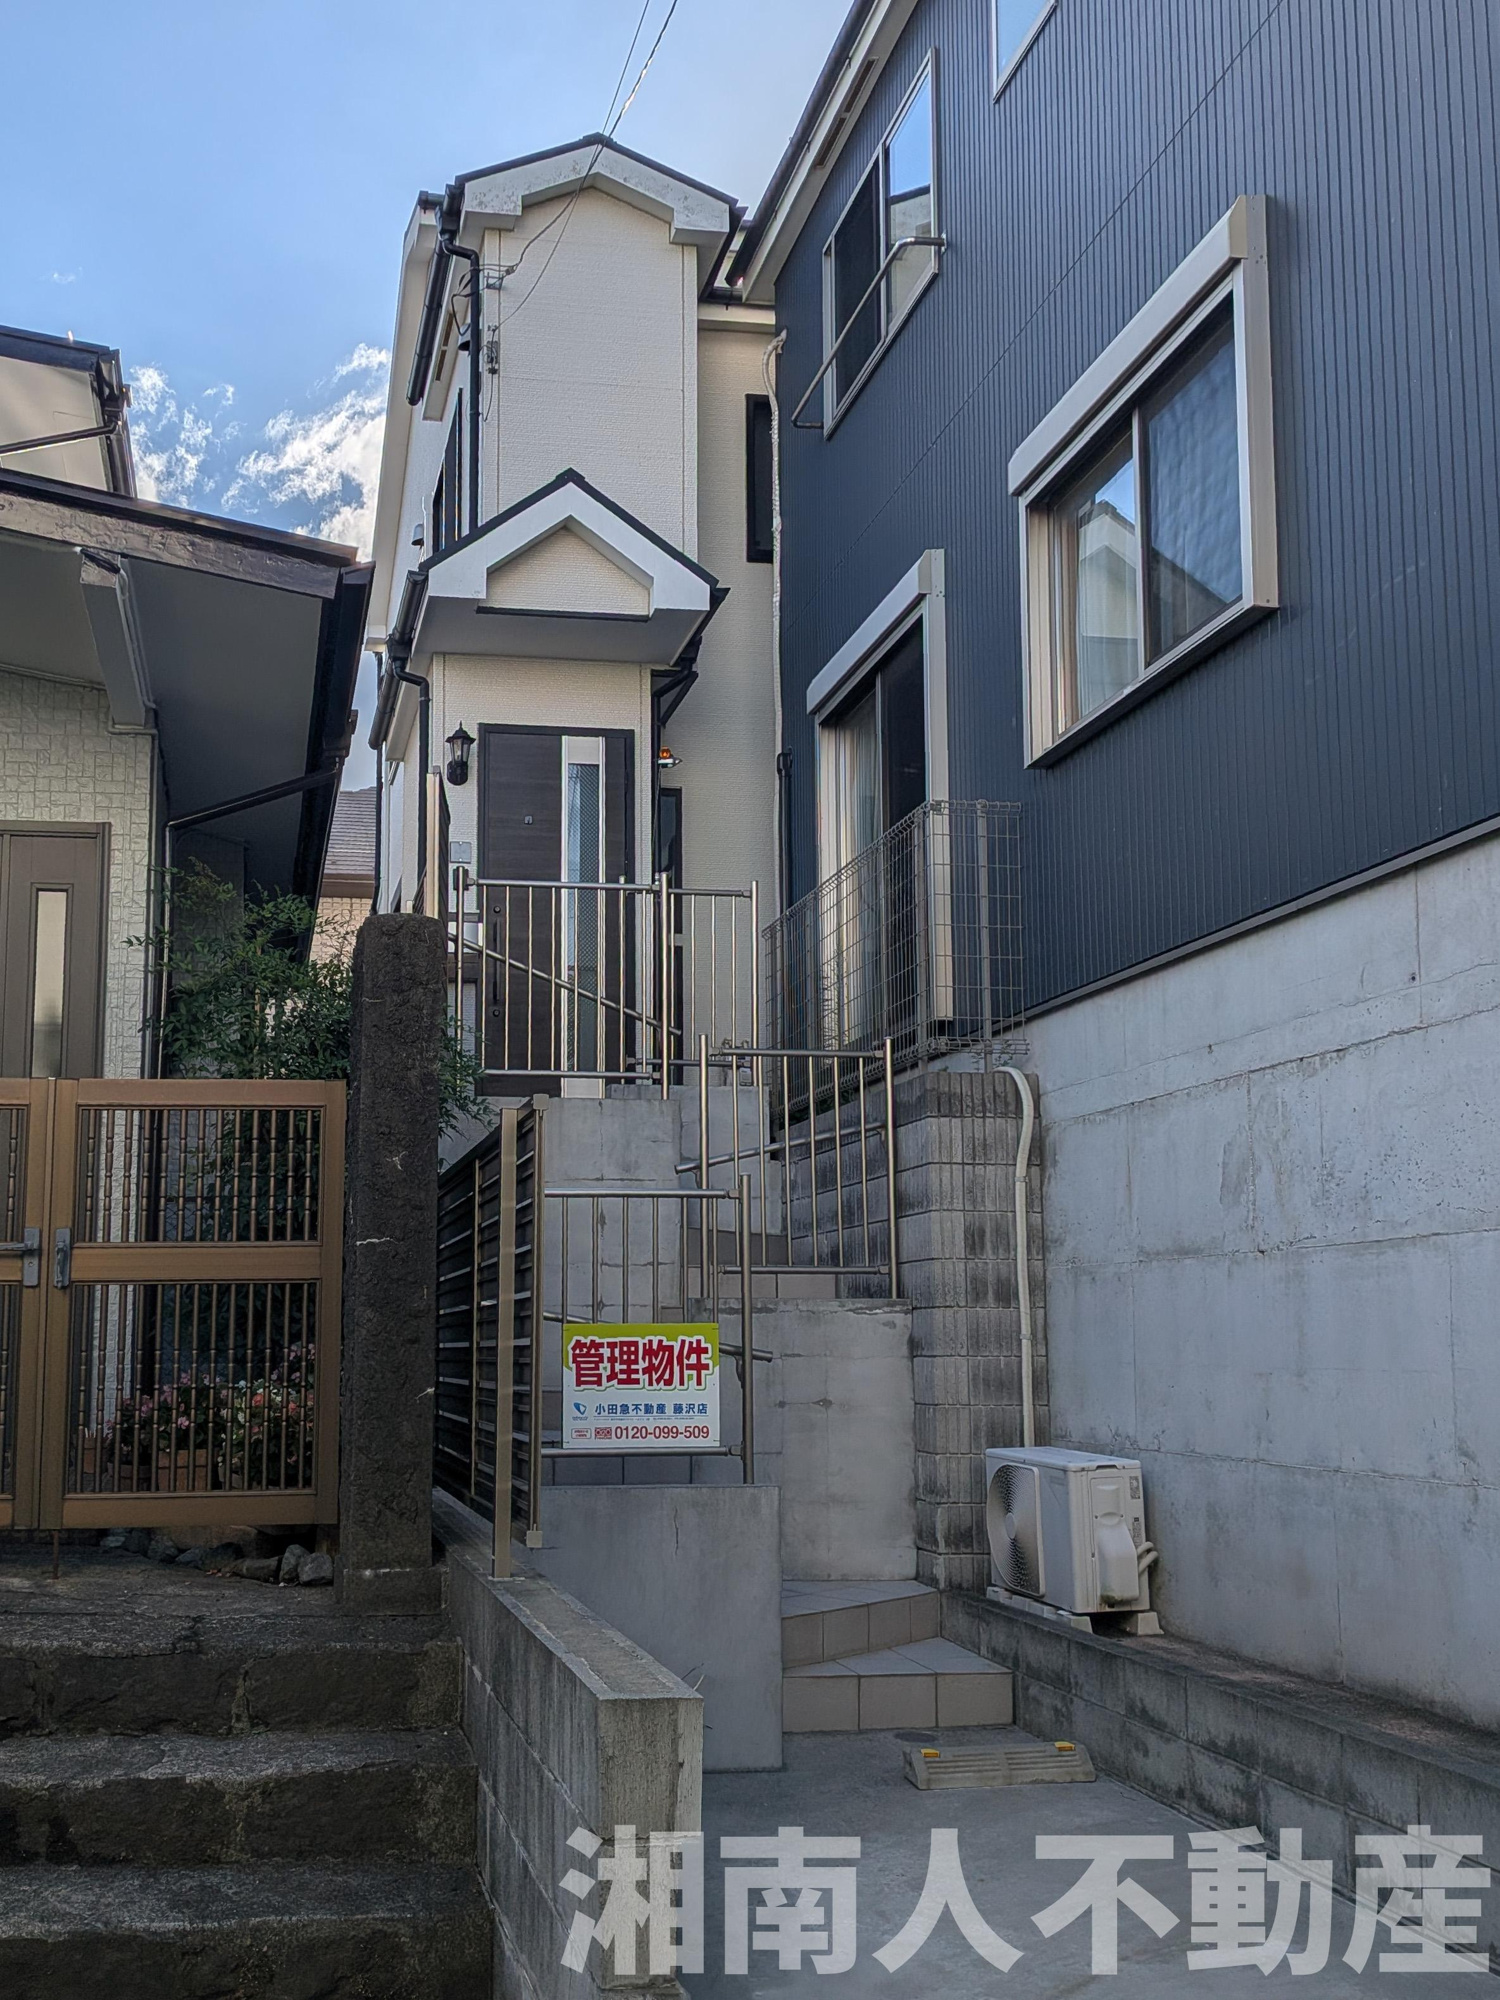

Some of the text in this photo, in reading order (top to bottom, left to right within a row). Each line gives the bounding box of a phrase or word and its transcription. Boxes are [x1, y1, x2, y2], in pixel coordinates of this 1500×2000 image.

[571, 1339, 710, 1387] 管理物件
[595, 1403, 708, 1415] 小田急不動産 藤沢店
[615, 1425, 710, 1439] 0120-099-509
